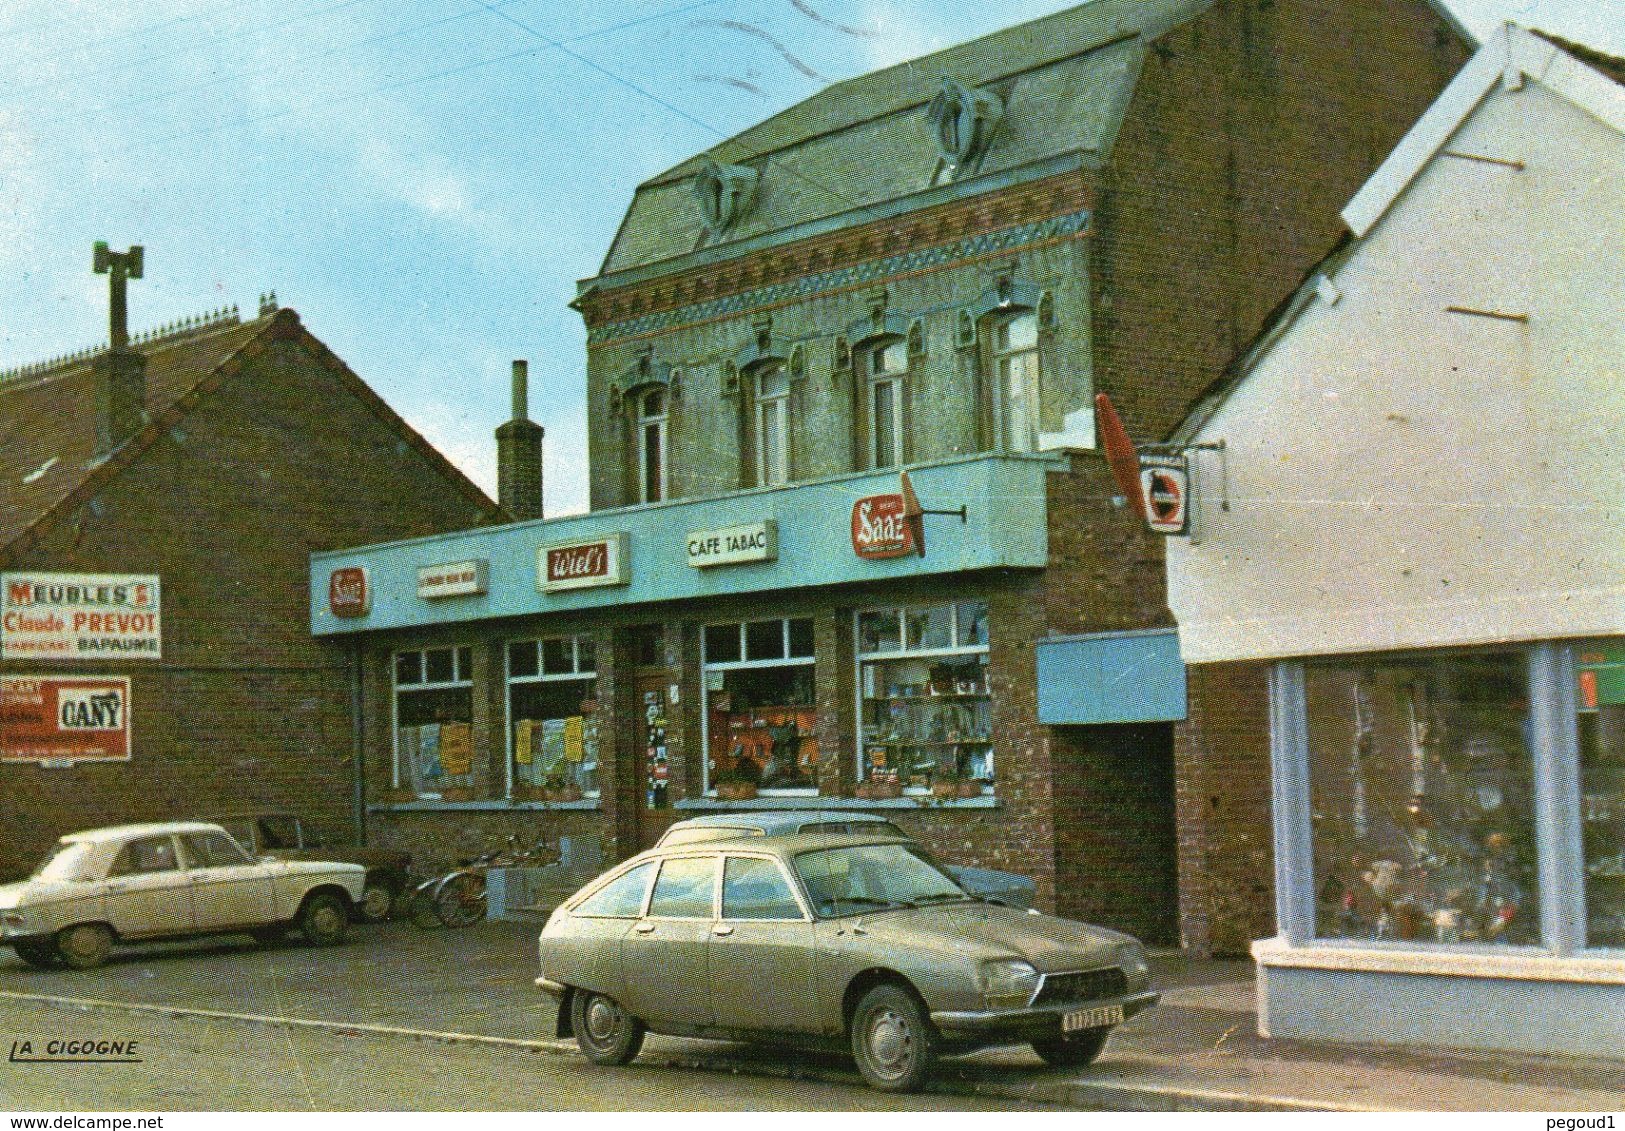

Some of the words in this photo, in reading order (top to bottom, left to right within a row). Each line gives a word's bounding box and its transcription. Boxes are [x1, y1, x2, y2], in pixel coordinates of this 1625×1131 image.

[856, 500, 905, 544] Saaz
[688, 538, 720, 557] CAFE
[726, 531, 766, 553] TABAC
[552, 547, 603, 578] Wiel's
[9, 582, 128, 606] MEUBLES
[4, 610, 65, 633] Claude
[73, 611, 155, 633] PREVOT
[78, 637, 157, 652] BAPAUME
[62, 700, 120, 728] CANY
